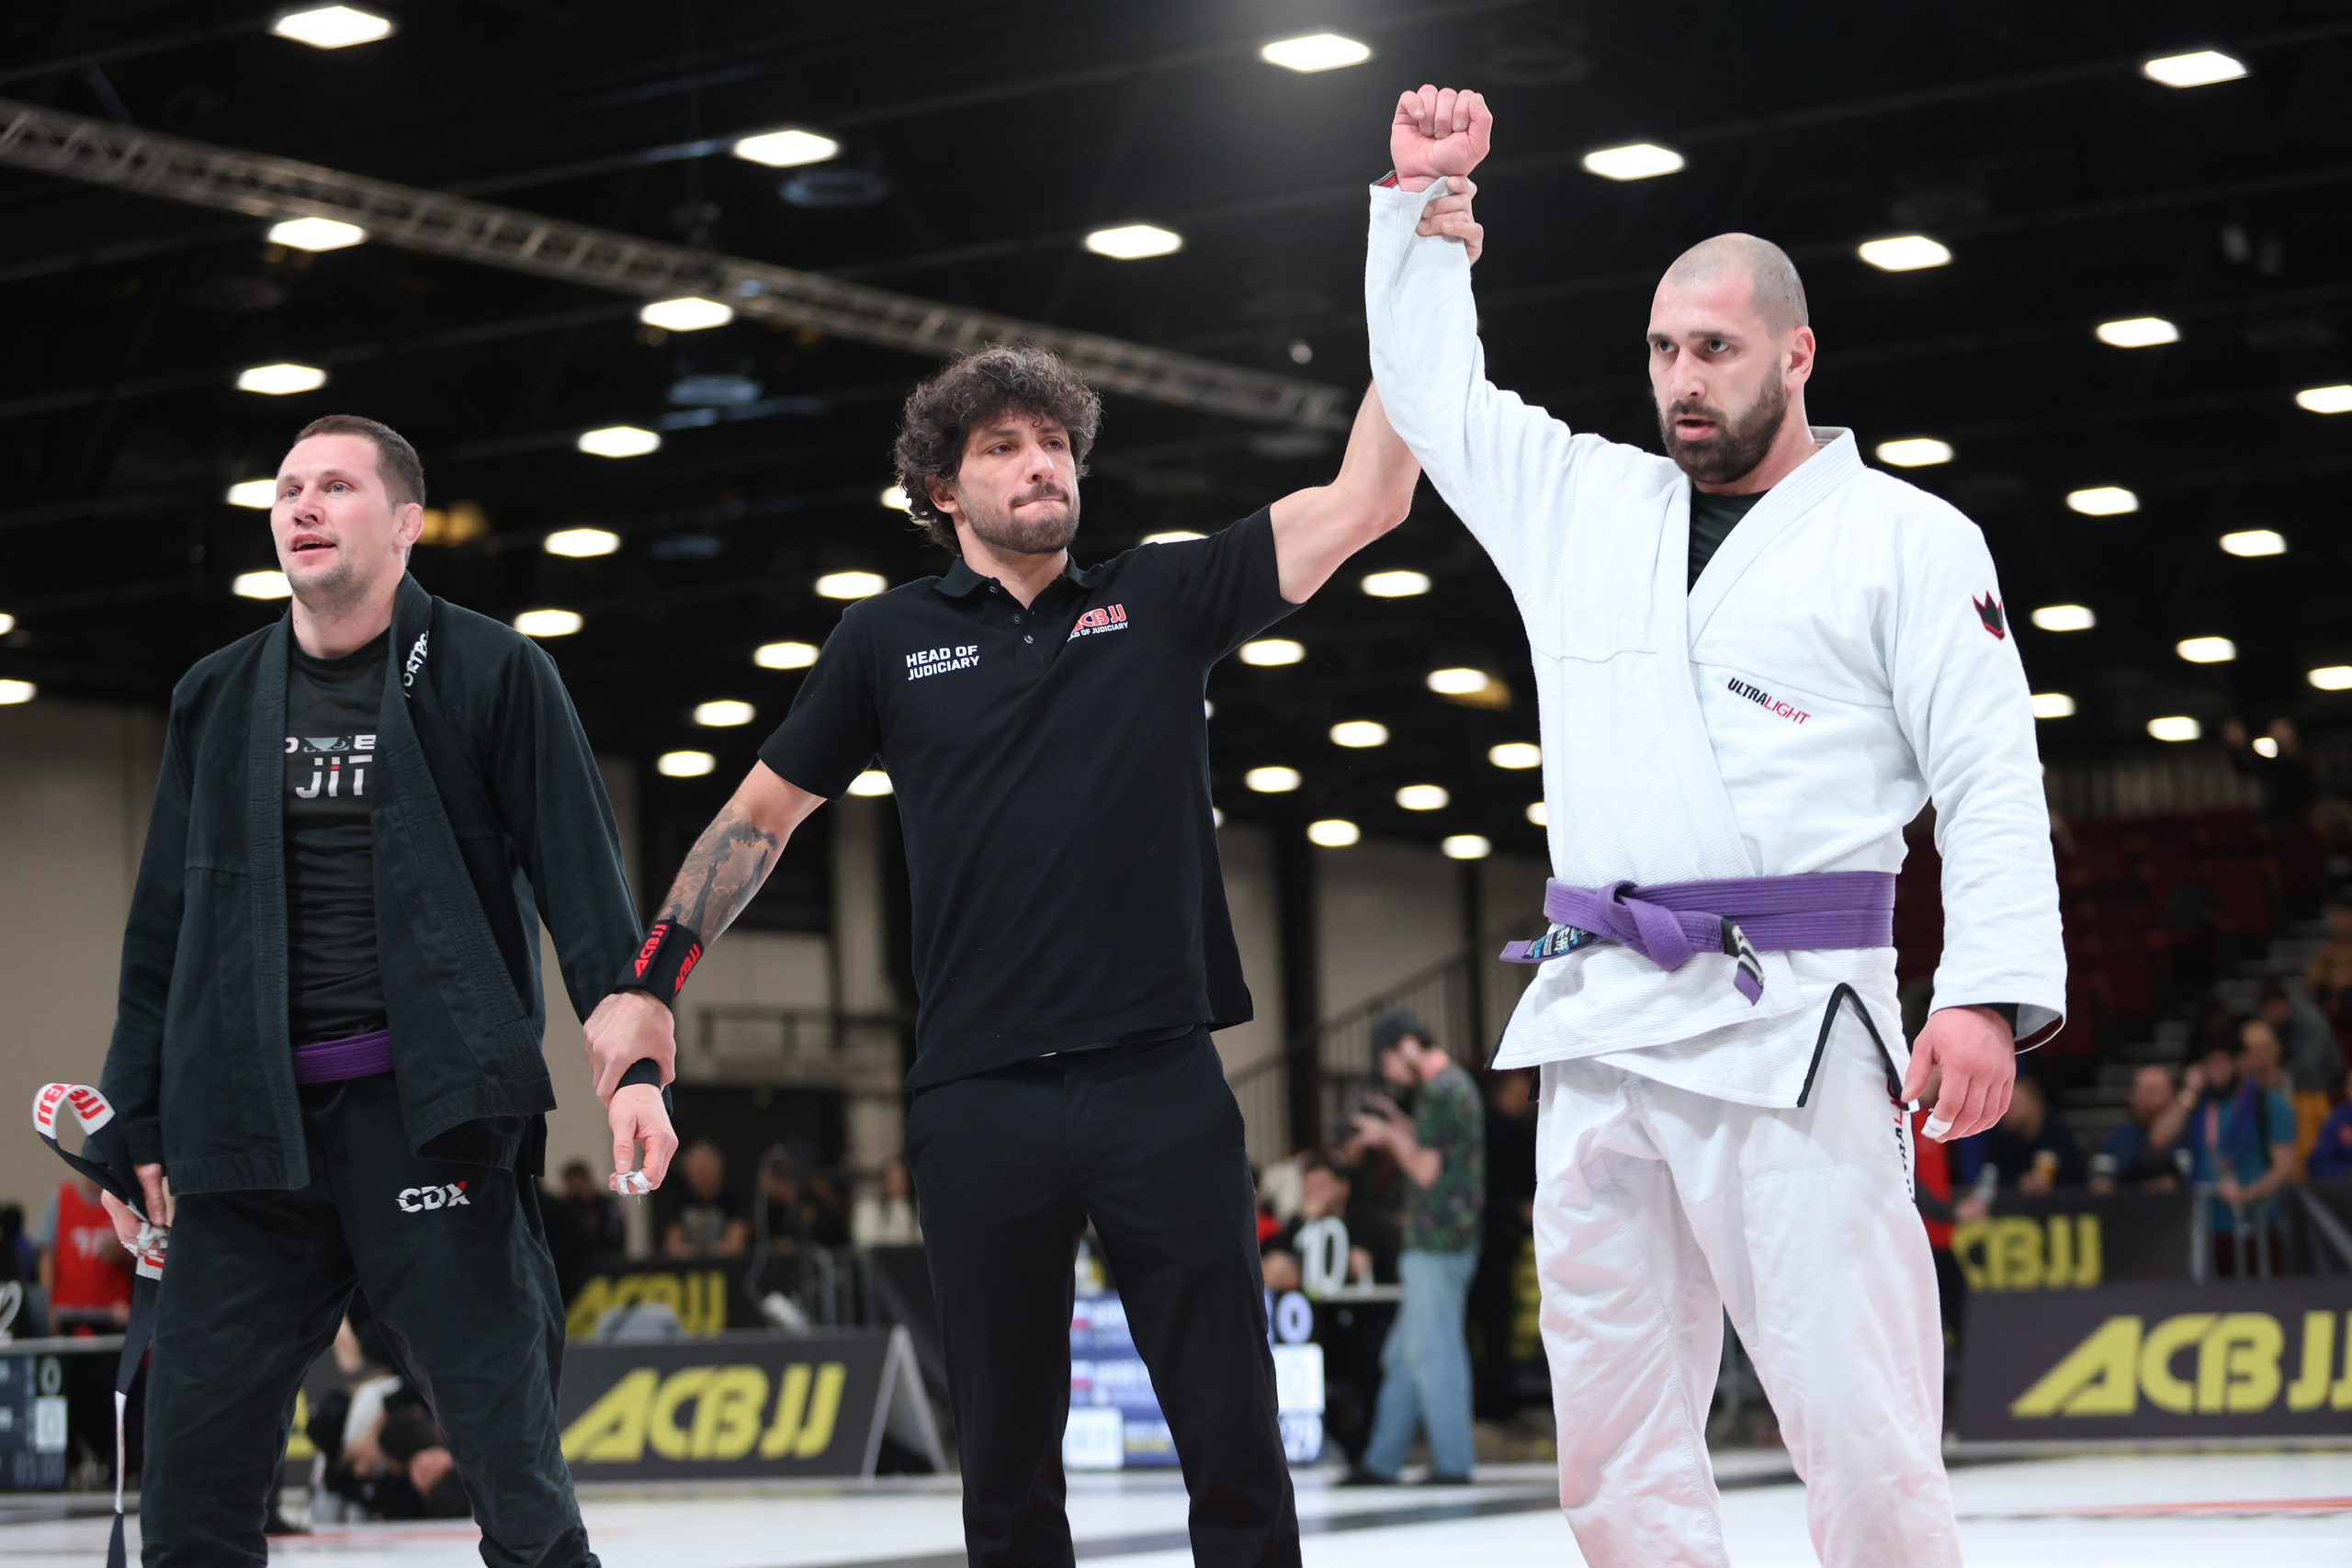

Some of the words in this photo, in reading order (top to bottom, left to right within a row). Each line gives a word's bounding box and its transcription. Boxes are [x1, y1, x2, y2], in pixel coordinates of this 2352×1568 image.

[1067, 630, 1081, 643] AD
[1080, 627, 1091, 637] OF
[1091, 622, 1128, 635] JUDICIARY
[906, 647, 951, 668] HEAD
[956, 645, 978, 657] OF
[908, 655, 980, 682] JUDICIARY
[1727, 677, 1812, 725] ULTRALIGHT
[634, 923, 668, 978] ACBJJ
[395, 1181, 470, 1213] CDX
[1952, 1213, 2104, 1292] CBJJ
[560, 1361, 847, 1463] ACBJJ
